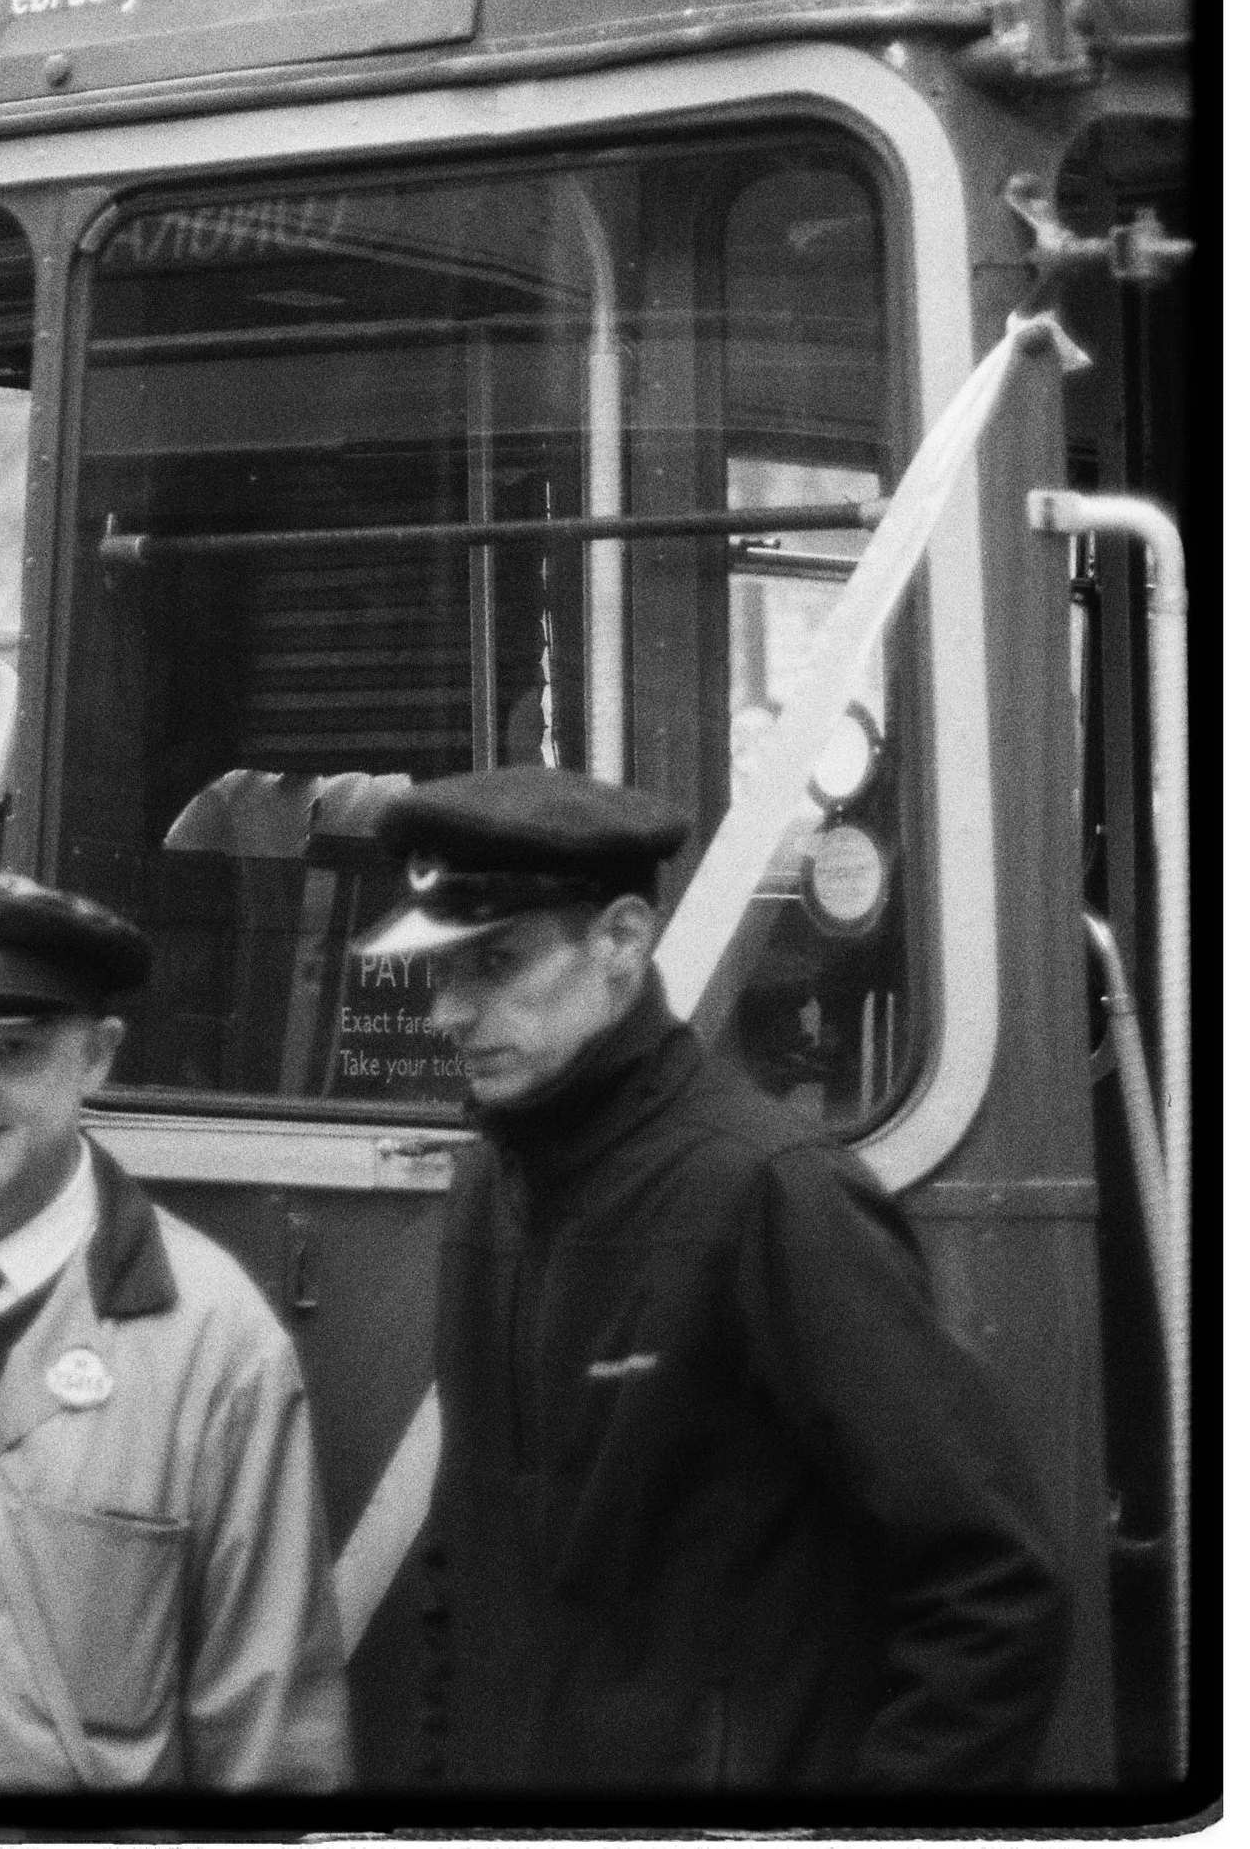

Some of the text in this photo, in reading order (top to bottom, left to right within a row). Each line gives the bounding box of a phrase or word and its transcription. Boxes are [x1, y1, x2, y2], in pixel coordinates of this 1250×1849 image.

[361, 947, 414, 988] PAY
[340, 1006, 390, 1033] Exact
[339, 1049, 473, 1084] Take your ticke
